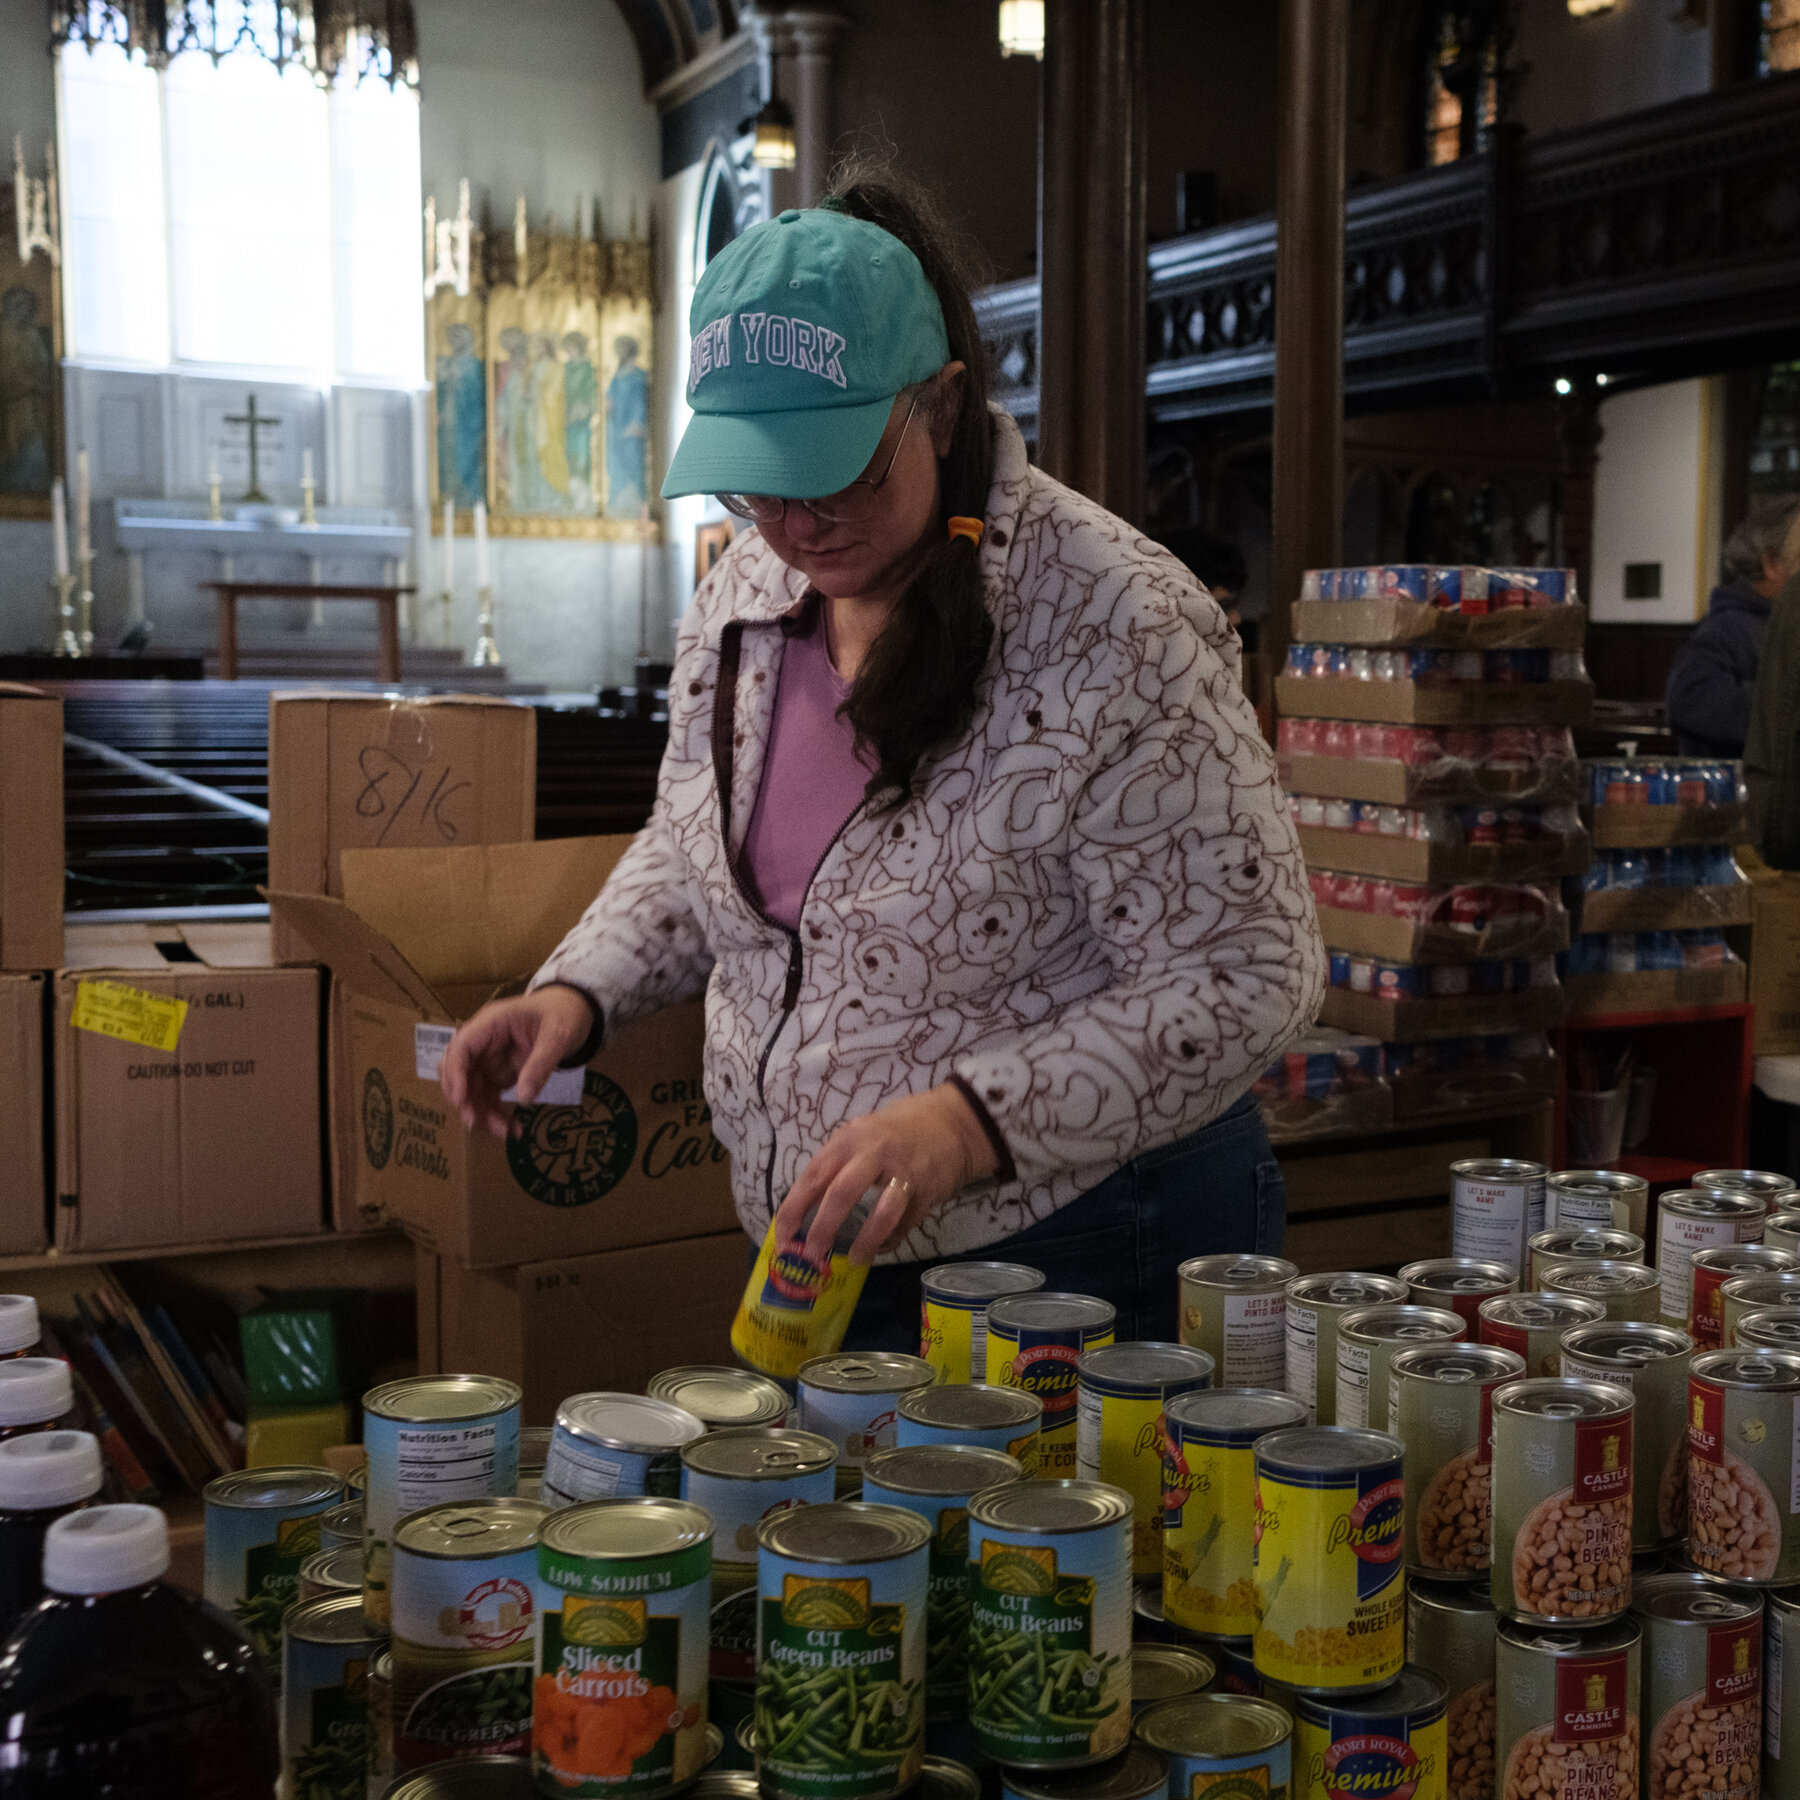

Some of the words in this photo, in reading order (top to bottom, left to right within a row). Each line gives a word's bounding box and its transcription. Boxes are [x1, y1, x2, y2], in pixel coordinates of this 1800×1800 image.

[690, 313, 732, 393] NEW
[740, 312, 847, 389] YORK
[529, 1169, 616, 1204] FARMS
[1018, 1348, 1050, 1365] PORT
[1603, 1372, 1632, 1384] Facts
[400, 1431, 458, 1443] Nutrition
[463, 1426, 496, 1441] Facts
[1583, 1466, 1629, 1486] CASTLE
[1585, 1522, 1625, 1544] PINTO
[1582, 1540, 1626, 1563] BEANS
[548, 1565, 586, 1588] LOW
[590, 1570, 672, 1592] SODIUM
[999, 1593, 1032, 1612] CUT
[1354, 1600, 1387, 1618] WHOLE
[973, 1600, 1014, 1631] Green
[1020, 1614, 1084, 1634] Beans
[1347, 1615, 1390, 1637] SWEET
[806, 1629, 844, 1647] CUT
[562, 1645, 643, 1674] Sliced
[769, 1639, 824, 1668] Green
[831, 1644, 895, 1668] Beans
[555, 1668, 650, 1699] Carrots
[1714, 1667, 1759, 1689] CASTLE
[1563, 1708, 1620, 1724] CASTLE
[1572, 1721, 1613, 1732] CANNING
[452, 1721, 515, 1742] GREEN
[1717, 1722, 1754, 1746] PINTO
[1331, 1738, 1366, 1758] PORT
[1370, 1738, 1408, 1760] ROYAL
[1715, 1740, 1758, 1765] BEANS
[1306, 1751, 1436, 1791] Premium
[1567, 1764, 1615, 1784] PINTO
[1564, 1783, 1617, 1800] BEANS
